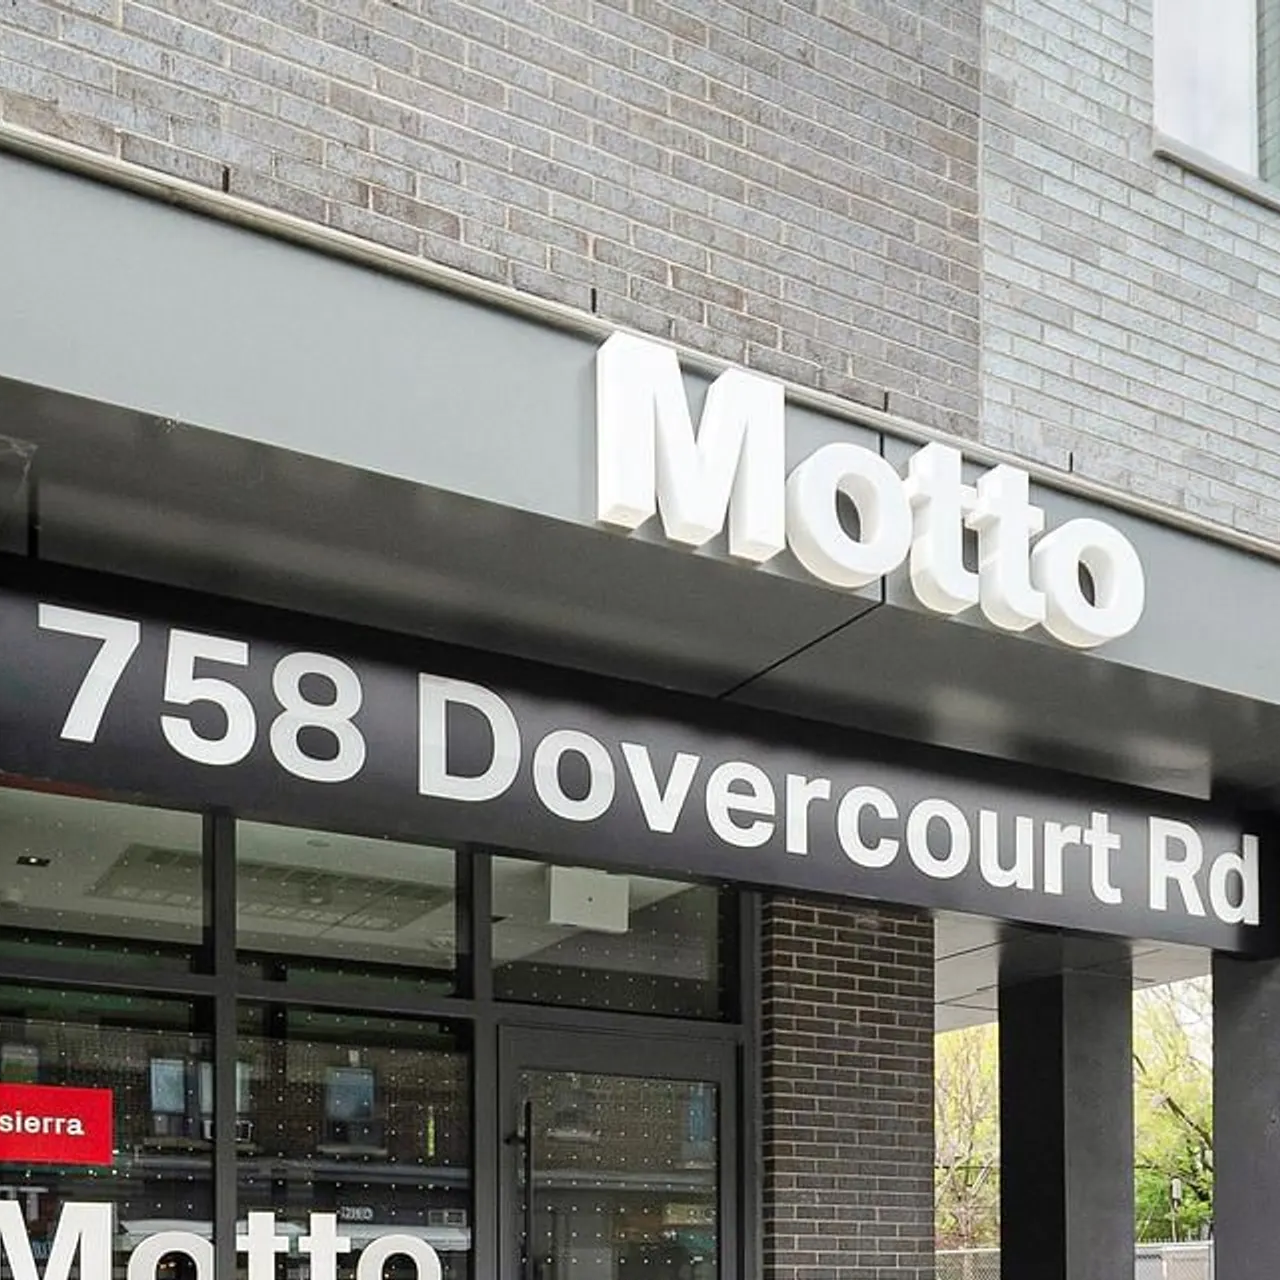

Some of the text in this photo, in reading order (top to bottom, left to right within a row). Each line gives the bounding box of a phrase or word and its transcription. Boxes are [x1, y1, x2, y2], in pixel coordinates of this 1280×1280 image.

[596, 330, 1145, 648] Motto
[38, 603, 1261, 925] 758 Dovercourt Rd
